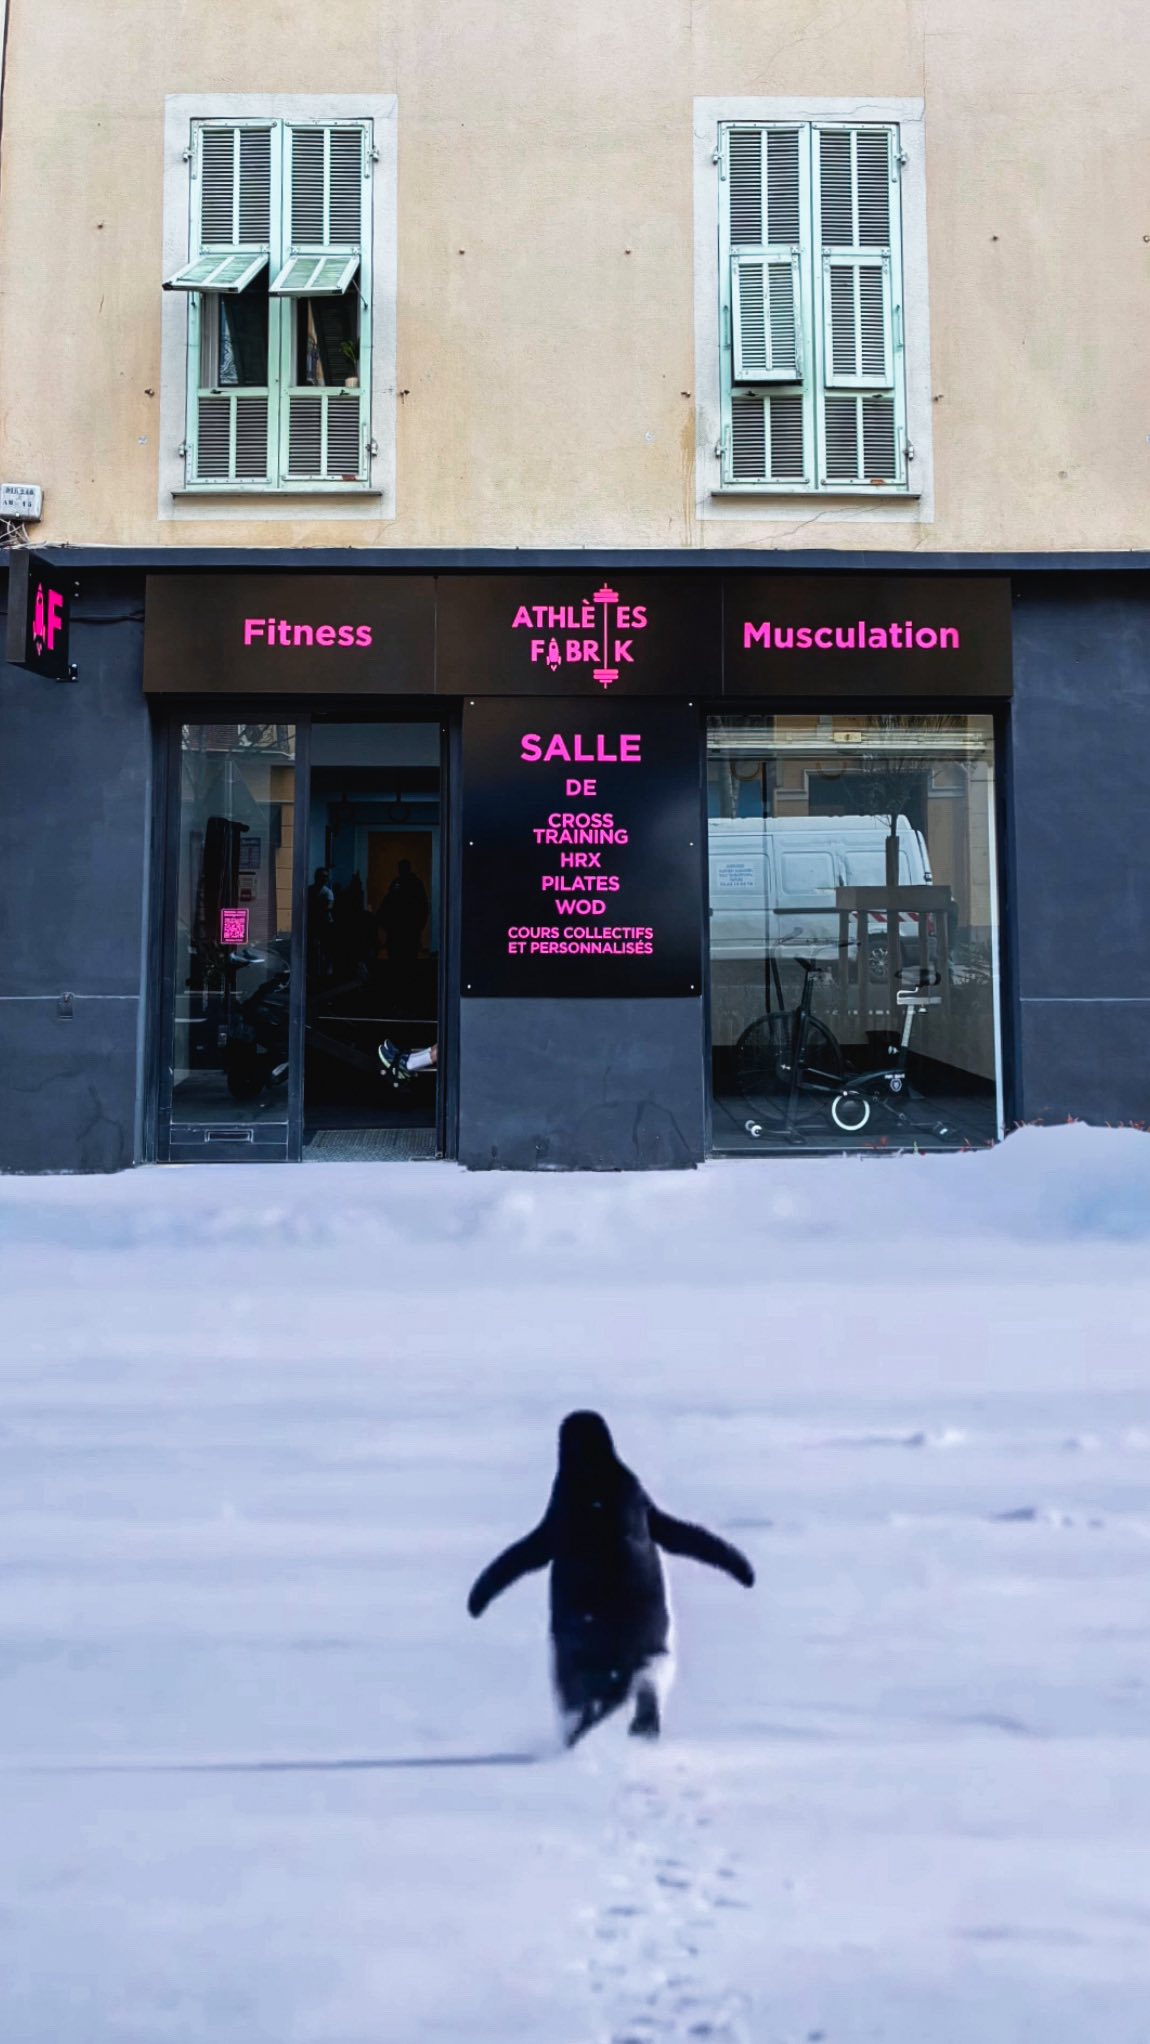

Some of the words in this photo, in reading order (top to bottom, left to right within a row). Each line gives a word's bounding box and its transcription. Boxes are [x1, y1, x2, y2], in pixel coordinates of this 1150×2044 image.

[243, 618, 373, 648] Fitness
[743, 620, 960, 650] Musculation
[520, 733, 642, 763] SALLE
[565, 779, 597, 797] DE
[547, 812, 614, 829] CROSS
[533, 828, 629, 845] TRAINING
[560, 852, 601, 868] HRX
[541, 875, 621, 892] PILATES
[555, 899, 607, 916] WOD
[507, 926, 560, 940] COURS
[563, 926, 654, 940] COLLECTIFS
[507, 941, 527, 954] ET
[530, 939, 654, 955] PERSONNALISÉS
